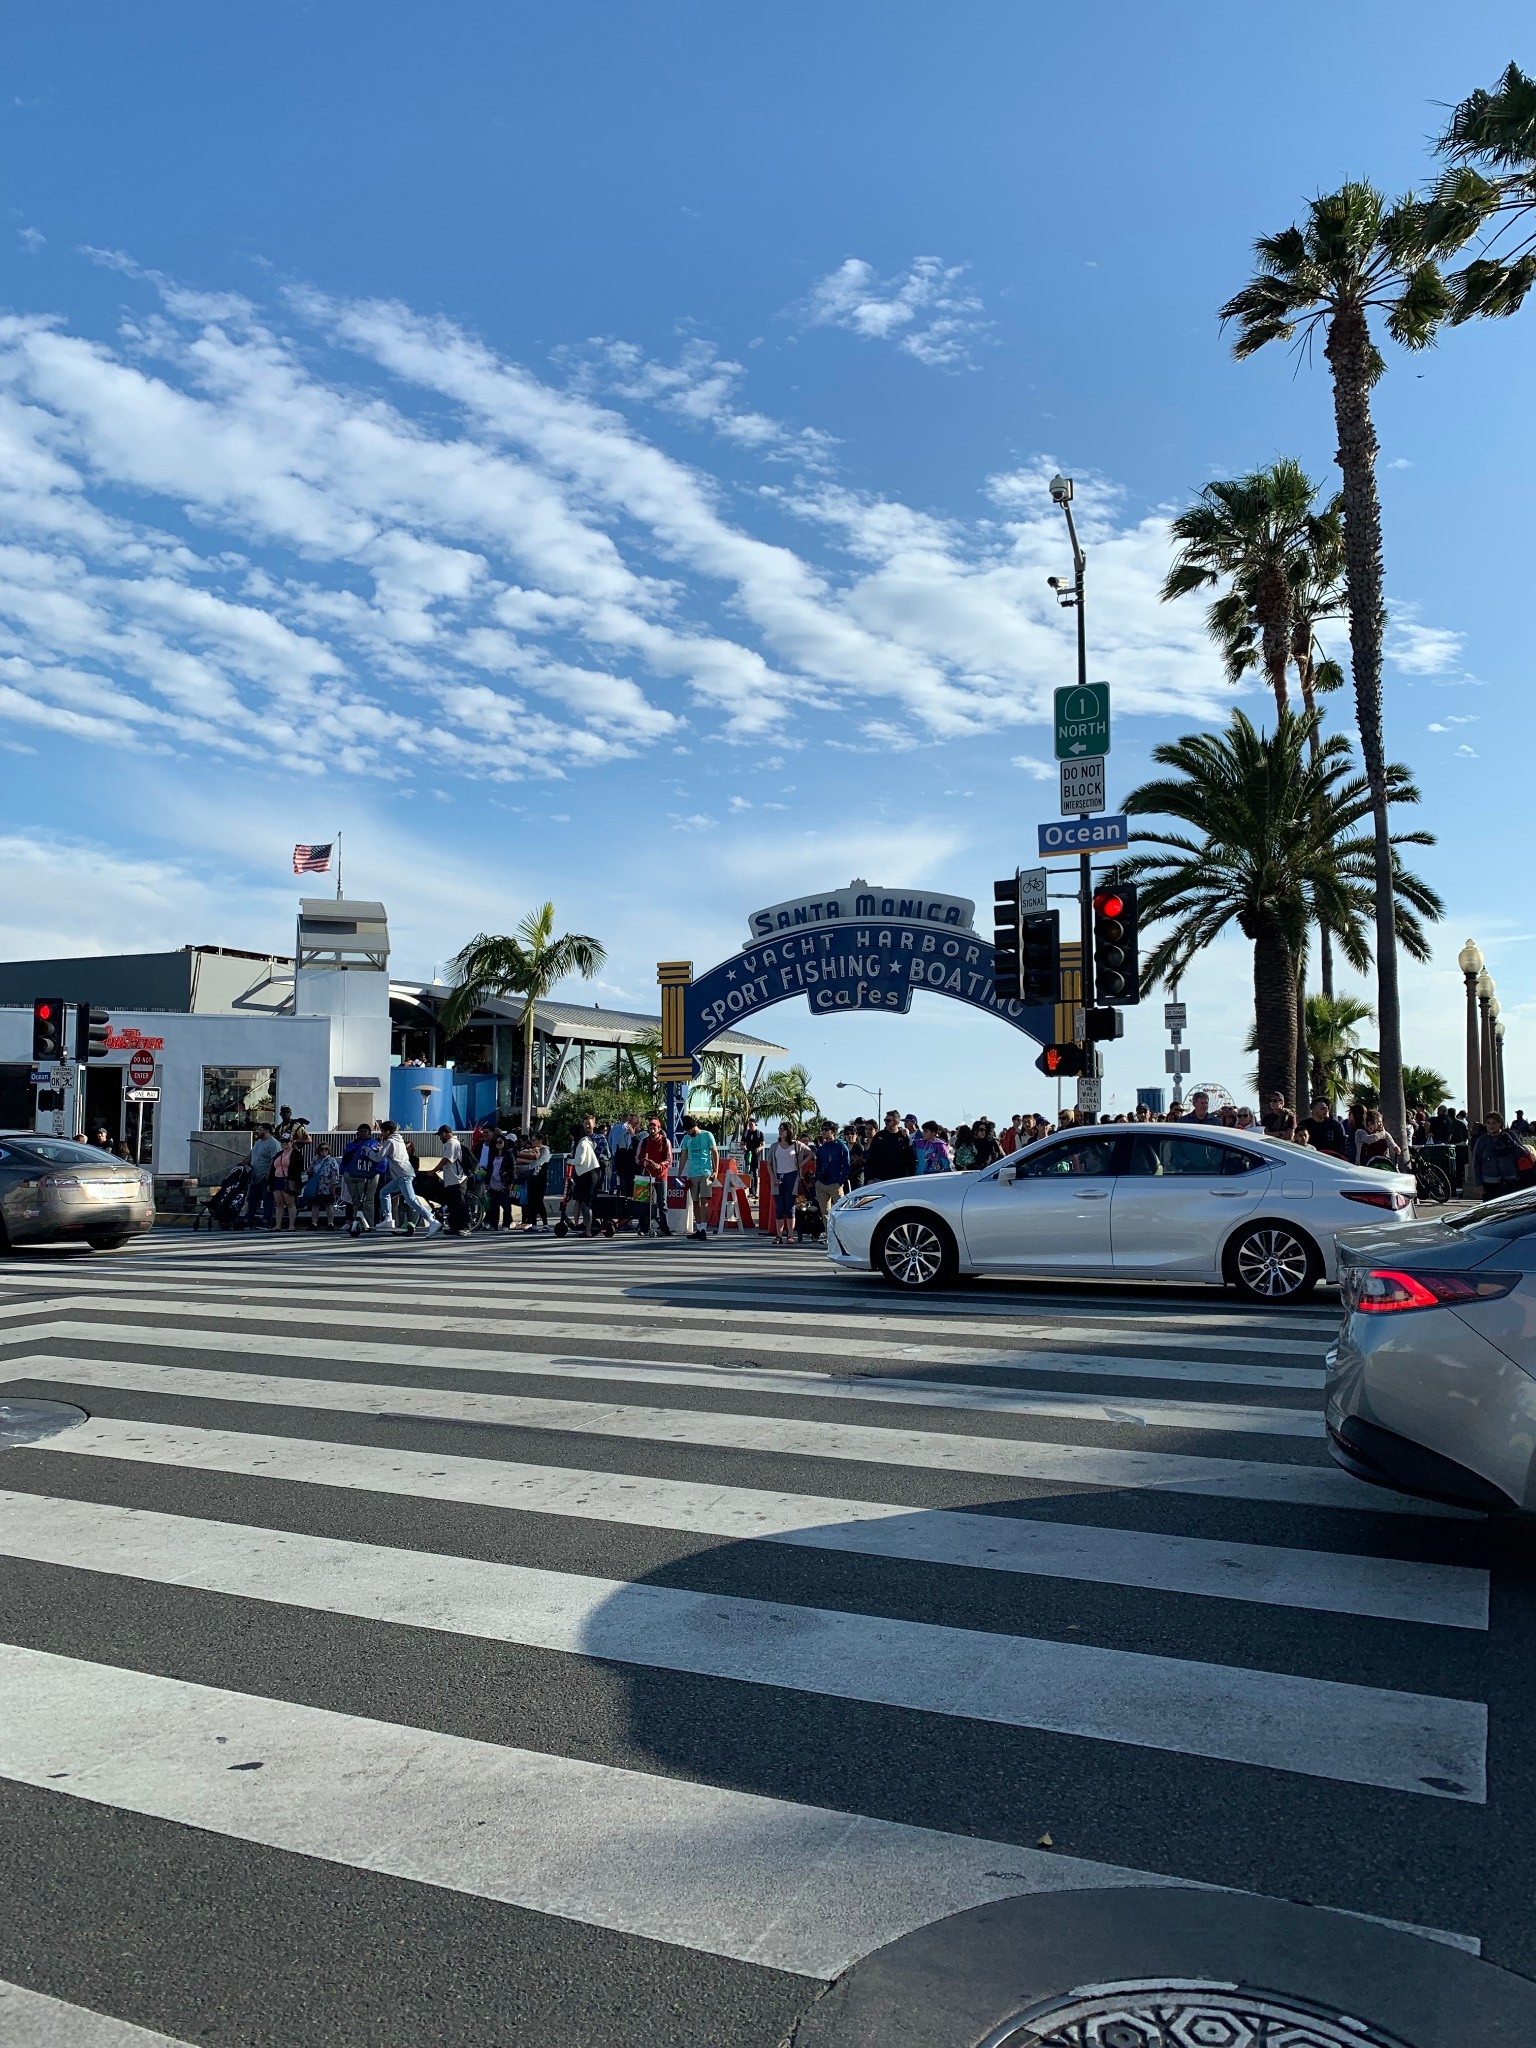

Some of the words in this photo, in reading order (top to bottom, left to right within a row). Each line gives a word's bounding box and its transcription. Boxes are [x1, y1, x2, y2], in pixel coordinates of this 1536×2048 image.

[1079, 698, 1085, 715] 1
[1059, 721, 1106, 739] NORTH
[1063, 767, 1078, 781] DO
[1081, 764, 1101, 778] NOT
[1064, 782, 1102, 798] BLOCK
[1063, 798, 1103, 811] INTERSECTION
[1045, 824, 1120, 846] Ocean
[1022, 897, 1045, 908] SIGNAL
[755, 901, 840, 937] SANTA
[856, 894, 961, 926] MONICA
[743, 933, 834, 974] YACHT
[857, 930, 980, 965] HARBOR
[701, 975, 769, 1030] SPORT
[780, 954, 881, 991] FISHING
[816, 981, 899, 1009] cafes
[51, 1078, 60, 1086] OK
[357, 1159, 373, 1171] GAP
